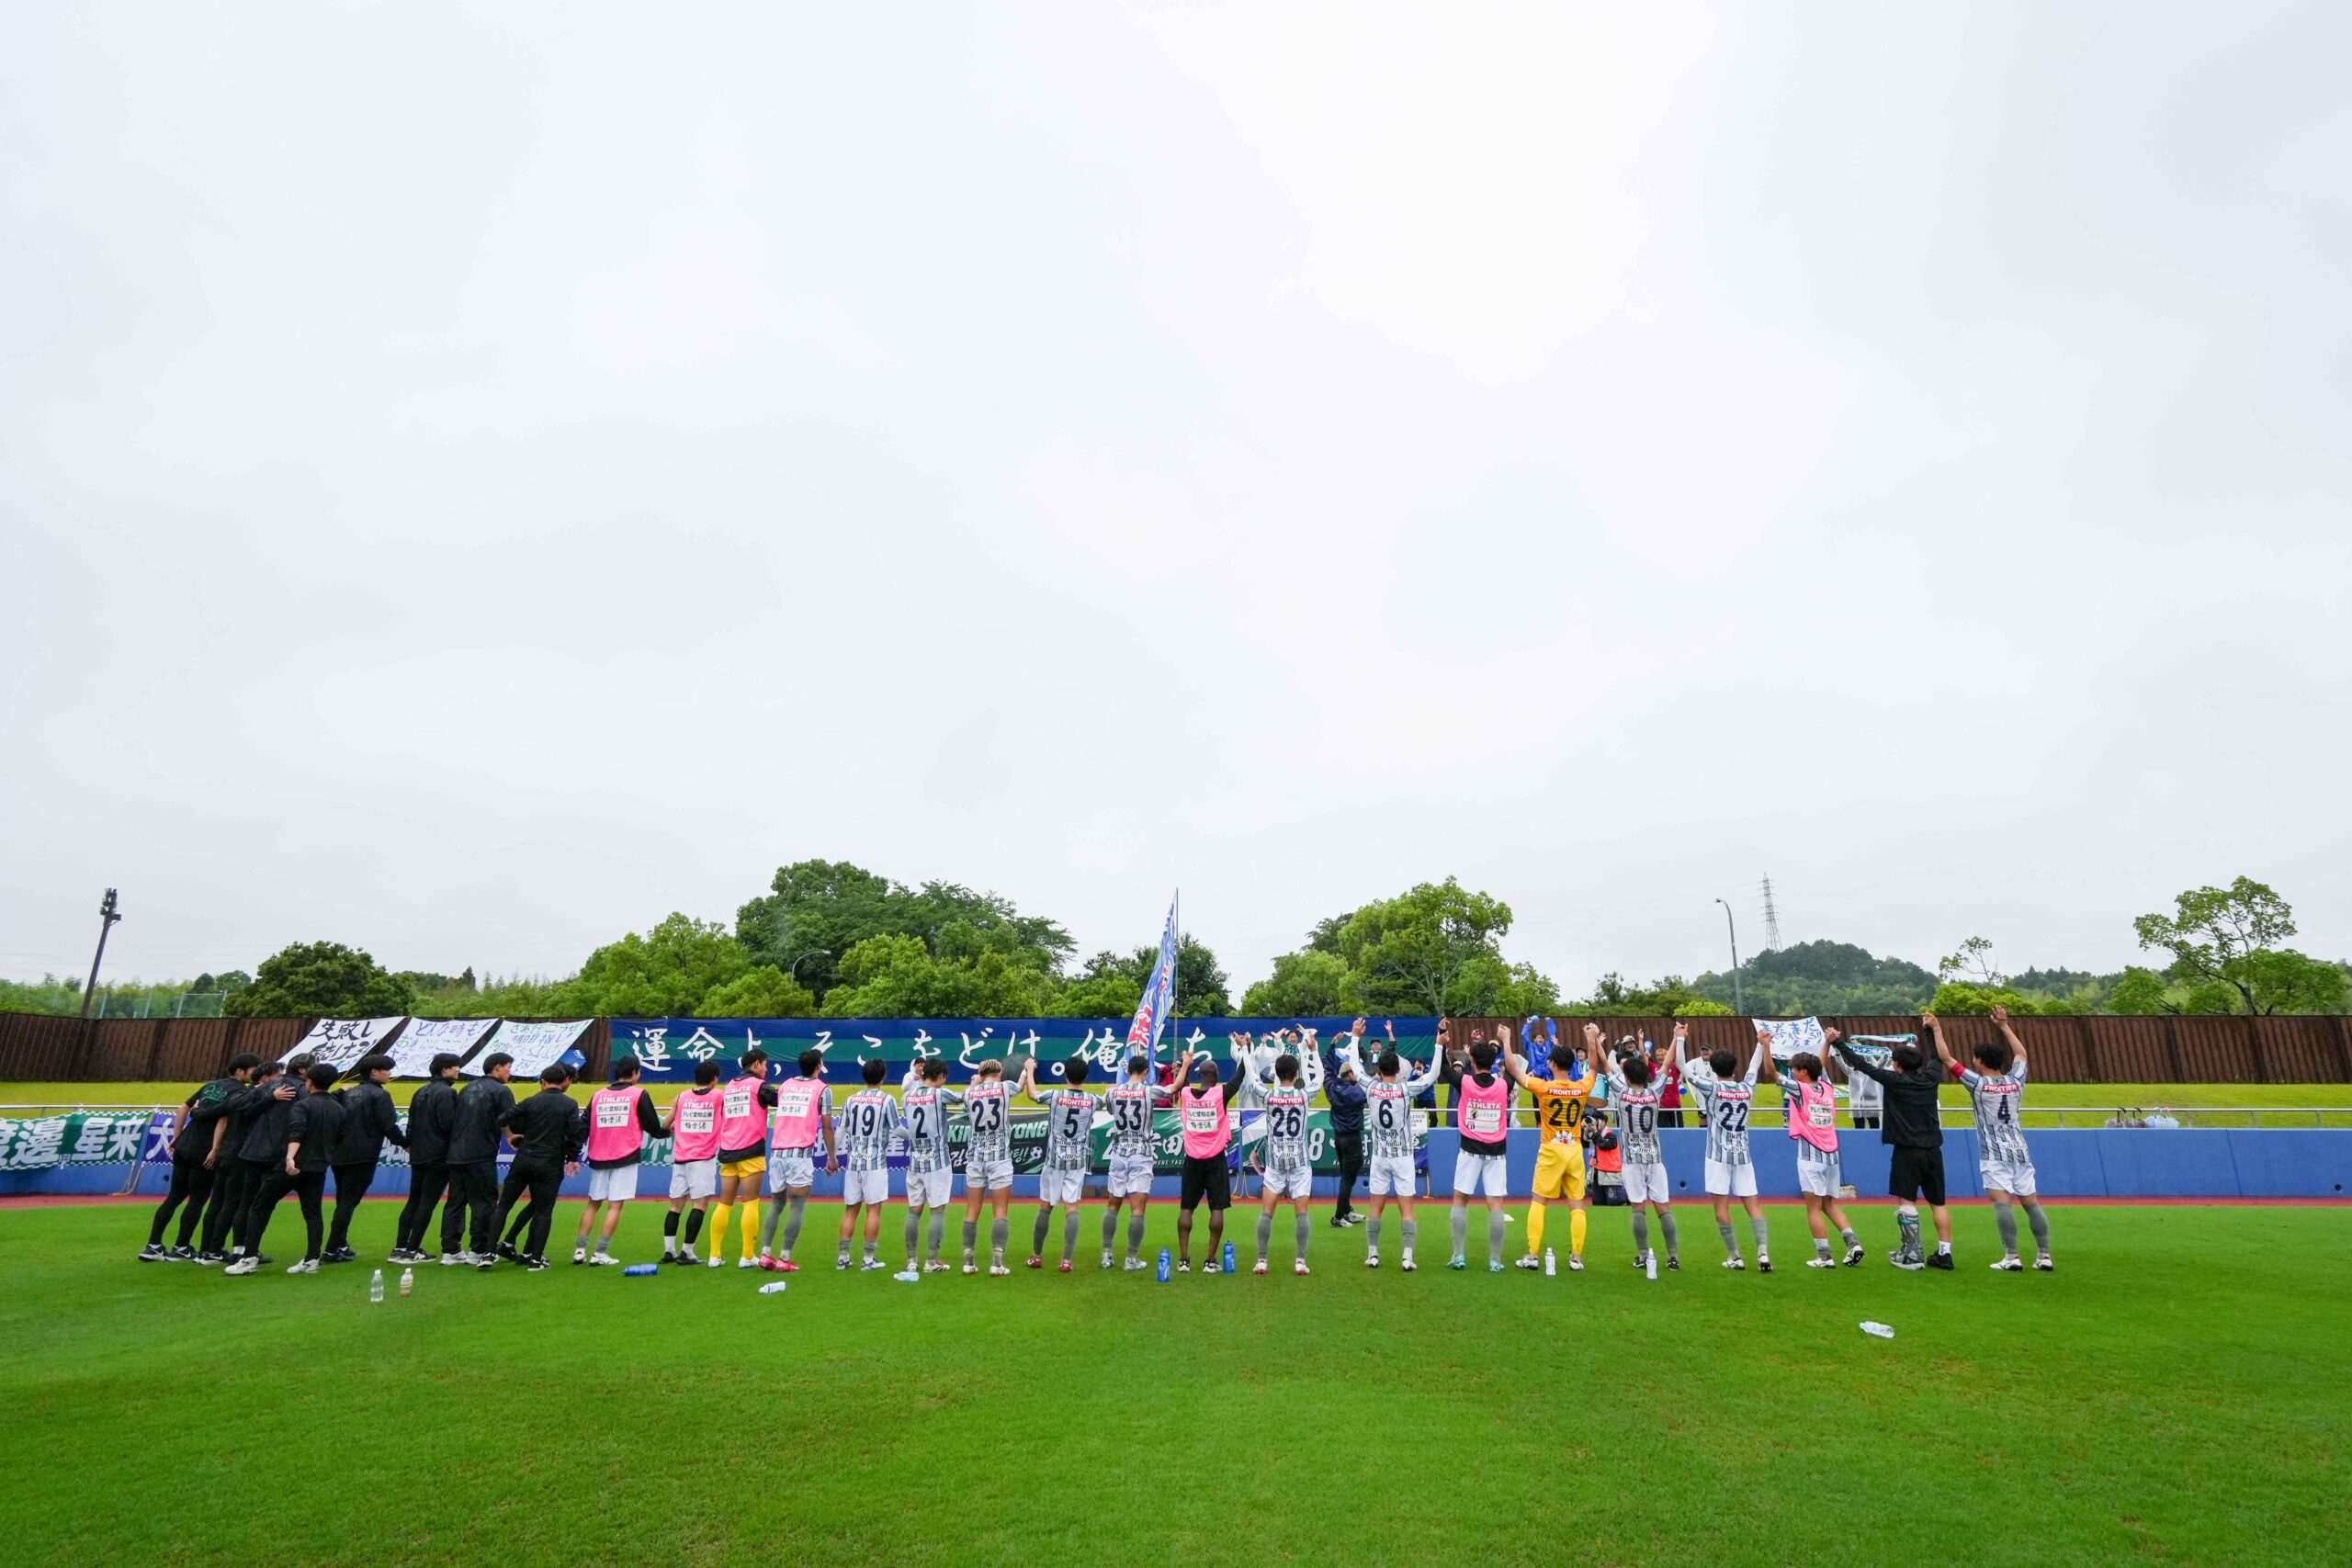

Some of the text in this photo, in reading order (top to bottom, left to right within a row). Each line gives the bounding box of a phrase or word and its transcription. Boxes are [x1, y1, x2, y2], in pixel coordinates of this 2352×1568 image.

[310, 1020, 373, 1042] 失敗し
[598, 1095, 630, 1103] ATHLETA
[907, 1094, 934, 1102] FRONTIER
[970, 1088, 1001, 1098] FRONTIER
[1058, 1097, 1091, 1107] FRONTIER
[1371, 1089, 1403, 1098] FRONTIER
[1623, 1093, 1656, 1102] FRONTIER
[852, 1104, 876, 1136] 19
[912, 1107, 928, 1139] 2
[971, 1098, 1001, 1132] 23
[1063, 1108, 1080, 1138] 5
[1115, 1100, 1142, 1131] 33
[1272, 1107, 1301, 1137] 26
[1379, 1100, 1393, 1129] 6
[1548, 1099, 1581, 1128] 20
[1624, 1104, 1654, 1134] 10
[1719, 1101, 1747, 1132] 22
[1997, 1095, 2011, 1124] 4
[72, 1116, 147, 1161] 星来
[1308, 1128, 1325, 1161] 8
